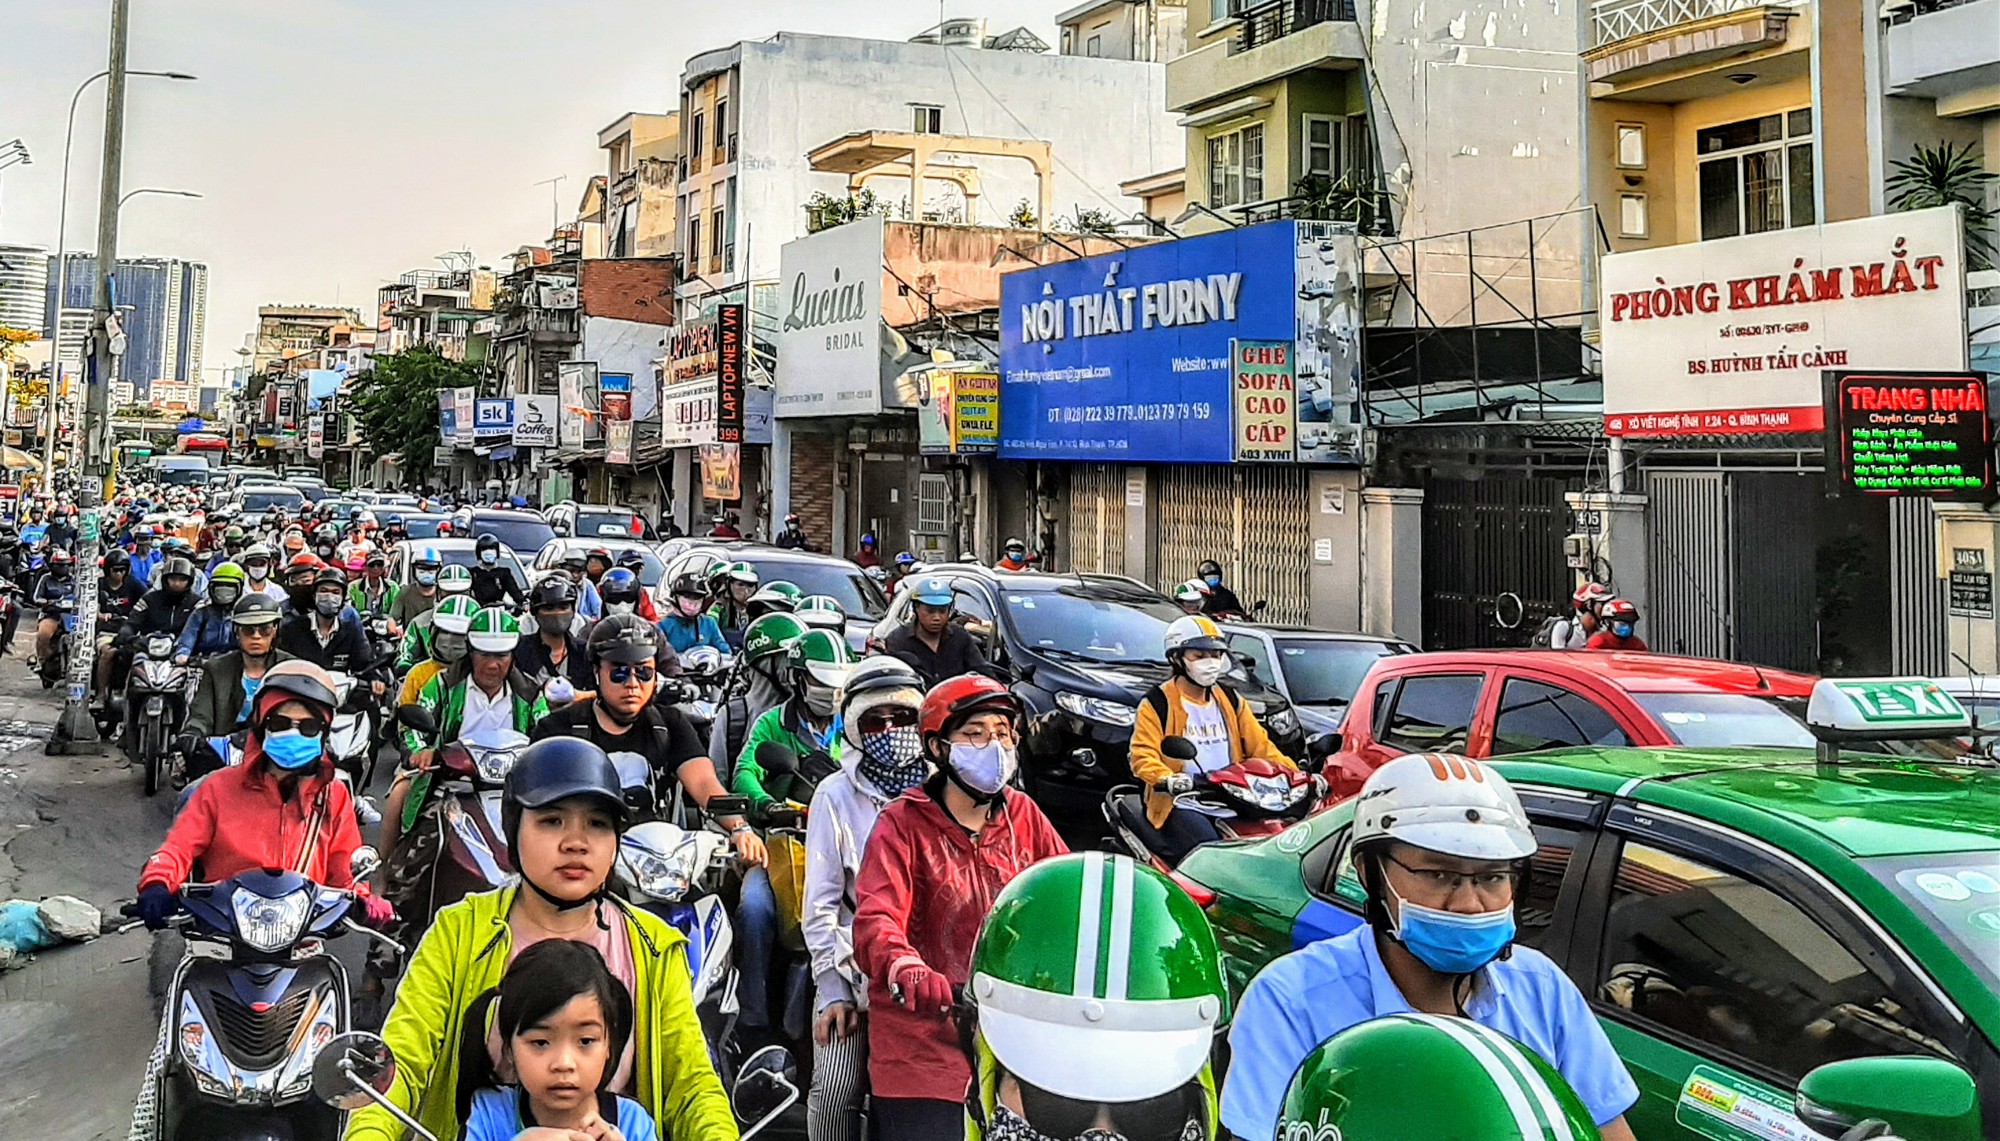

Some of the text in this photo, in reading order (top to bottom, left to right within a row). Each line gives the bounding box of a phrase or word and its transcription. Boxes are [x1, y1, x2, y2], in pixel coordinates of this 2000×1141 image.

[1610, 237, 1944, 322] PHÒNG KHÁM MẮT
[783, 267, 866, 333] Lucias
[1022, 262, 1242, 354] NỘI THẤT FURNY
[825, 331, 864, 351] BRIDAL
[722, 306, 737, 421] LAPTOPNEW.VN
[1242, 342, 1287, 365] GHẾ
[1766, 345, 1798, 370] TẤN
[1801, 345, 1848, 367] CẢNH
[969, 378, 997, 389] GUITAR
[1238, 372, 1292, 391] SOFA
[1245, 395, 1287, 415] CAO
[1847, 382, 1984, 412] TRANG NHÃ
[1085, 405, 1102, 421] 222
[1104, 405, 1115, 421] 39
[1162, 403, 1175, 420] 79
[1177, 402, 1189, 419] 79
[1192, 402, 1210, 419] 159
[1761, 413, 1790, 428] THẠNH
[1904, 413, 1927, 425] Cung
[517, 422, 554, 435] Coffee
[1245, 419, 1287, 443] CẤP
[1240, 450, 1260, 460] 403
[747, 631, 770, 652] Grab
